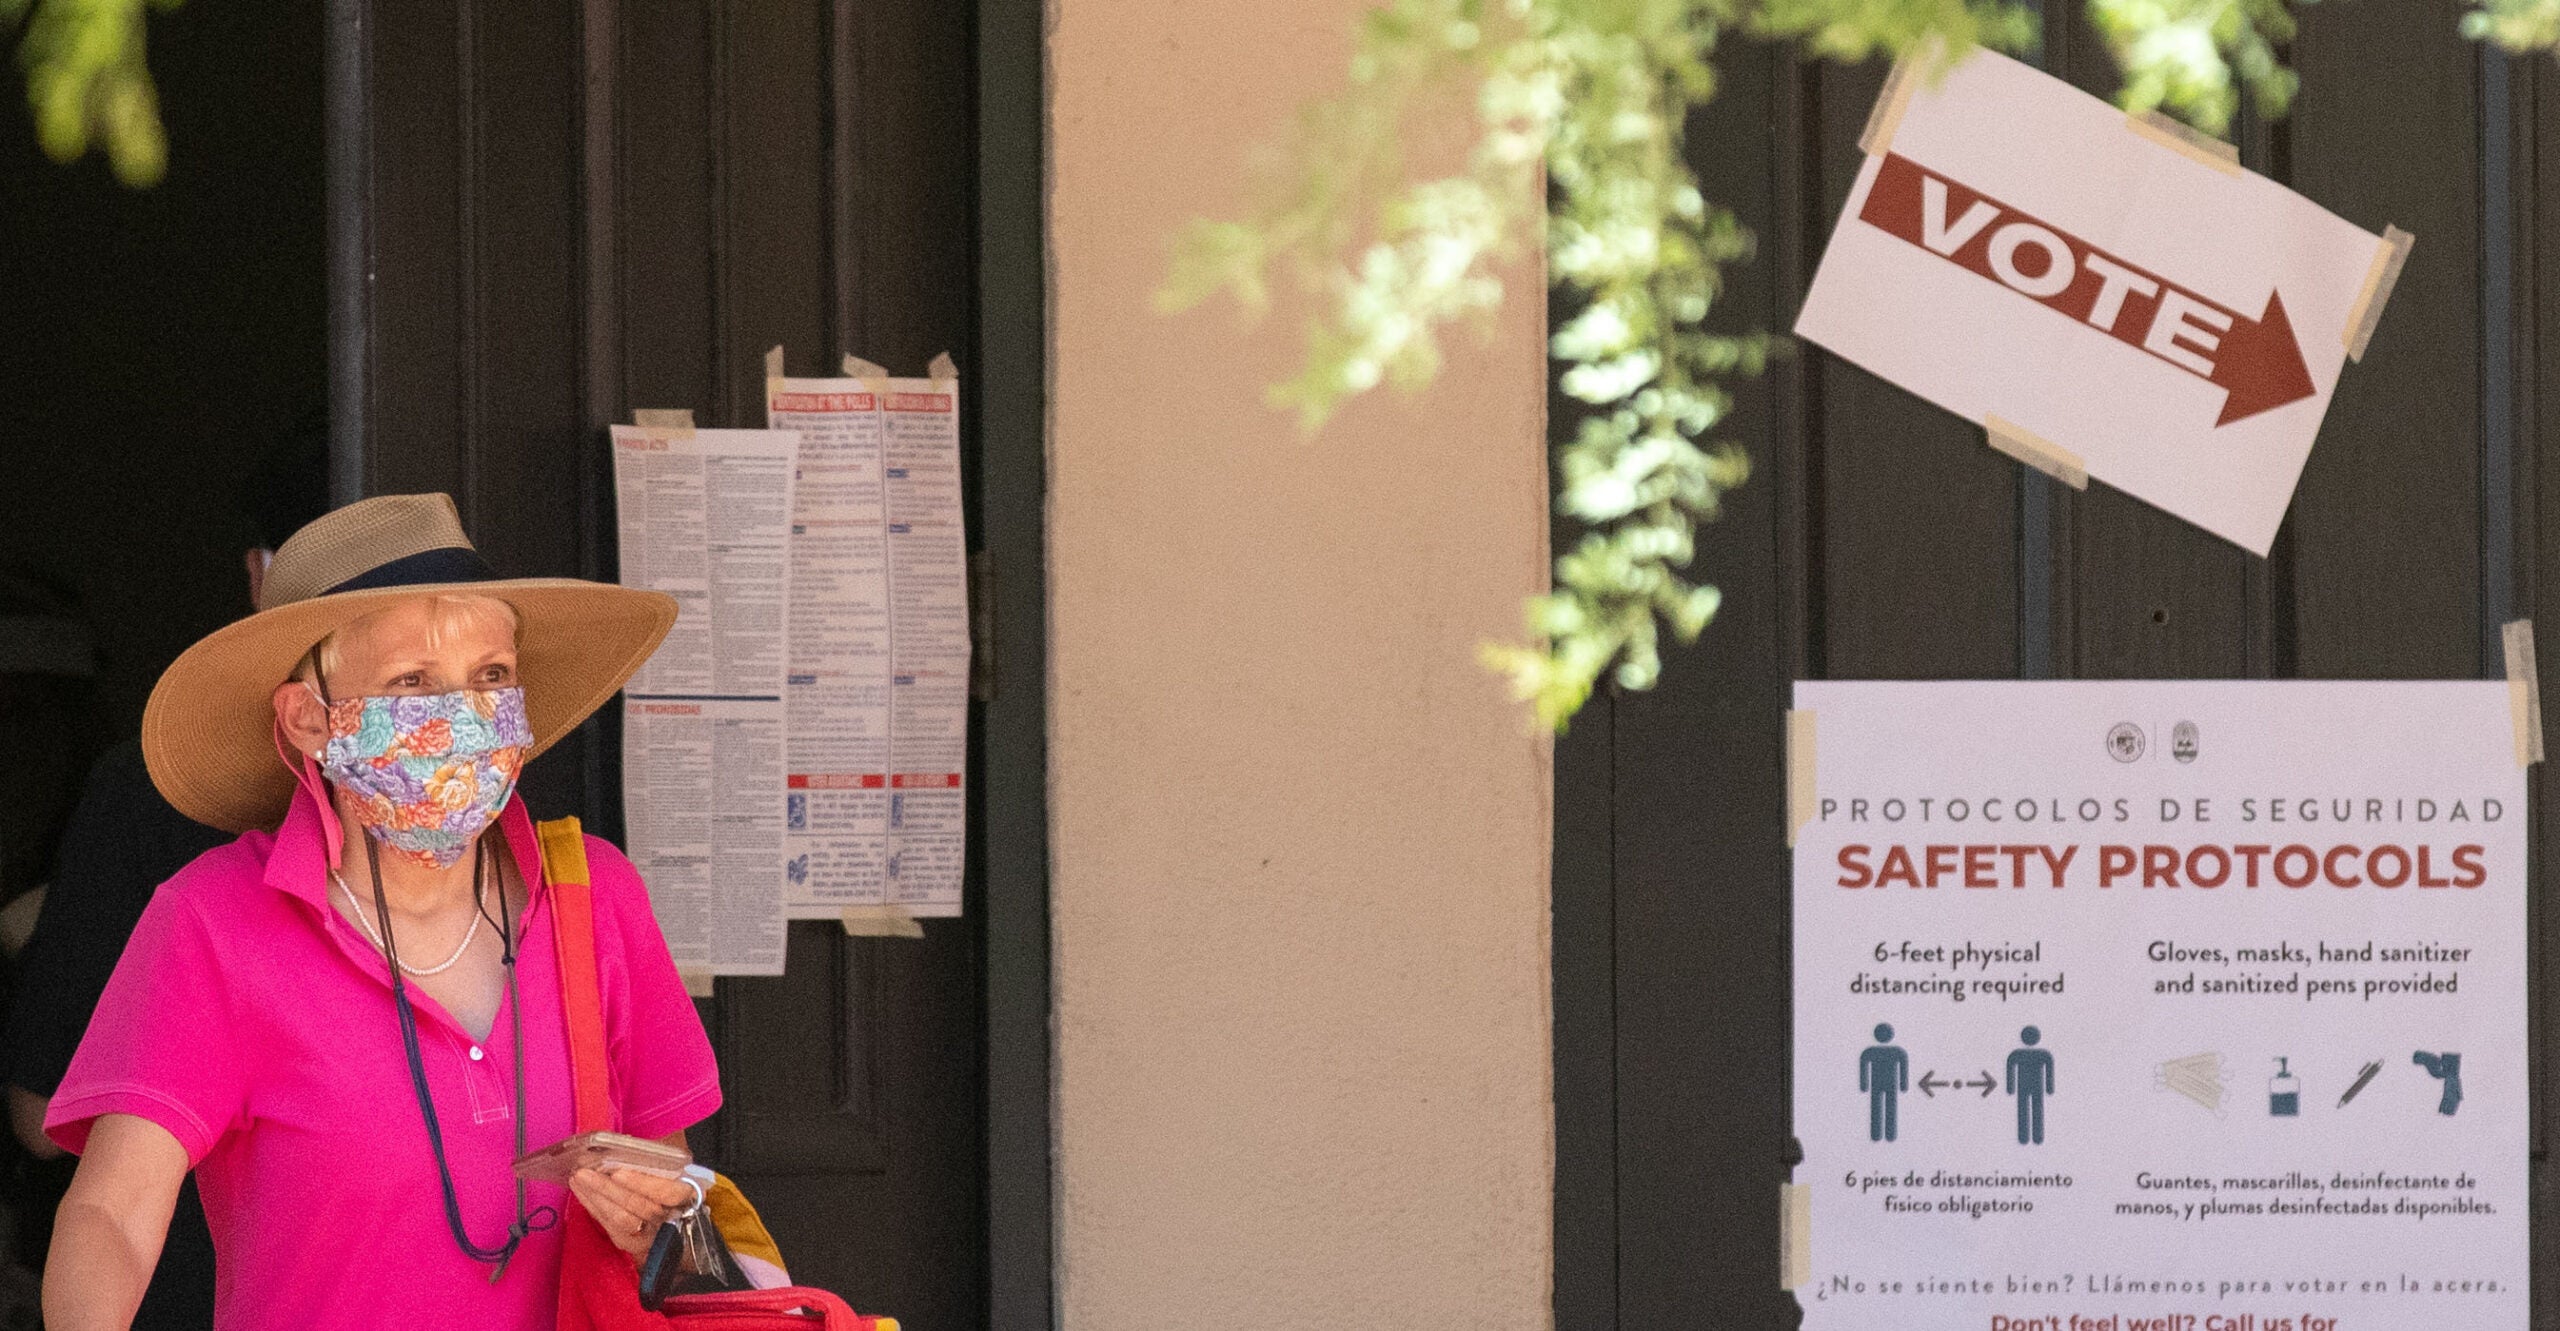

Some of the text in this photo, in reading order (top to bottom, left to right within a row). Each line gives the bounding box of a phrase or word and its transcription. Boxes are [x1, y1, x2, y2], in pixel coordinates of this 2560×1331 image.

[1922, 175, 2234, 377] VOTE
[1820, 797, 2504, 823] PROTOCOLOS DE SEGURIDAD
[1837, 844, 2487, 889] SAFETY PROTOCOLS
[1873, 940, 2041, 971] 6-feet physical
[2146, 939, 2472, 967] Gloves, masks, hand sanitizer
[1849, 972, 2065, 1003] distancing required
[2153, 971, 2458, 1001] and sanitized pens provided
[1844, 1170, 2073, 1194] 6 pies de distanciamiento
[2135, 1171, 2476, 1192] Guantes, mascarillas, desinfectante de
[1937, 1195, 2034, 1220] obligatorio
[2114, 1196, 2497, 1222] manos, y plumas desinfectadas disponibles.
[1879, 1282, 1903, 1294] se
[1916, 1276, 1994, 1294] siente
[2006, 1274, 2074, 1294] bien?
[2219, 1281, 2272, 1300] para
[2285, 1278, 2347, 1293] votar
[2360, 1281, 2387, 1293] en
[2400, 1274, 2420, 1293] la
[2069, 1314, 2118, 1331] feel
[2127, 1314, 2196, 1331] well?
[2205, 1314, 2254, 1331] Call
[2263, 1318, 2292, 1331] us
[2300, 1313, 2337, 1331] for
